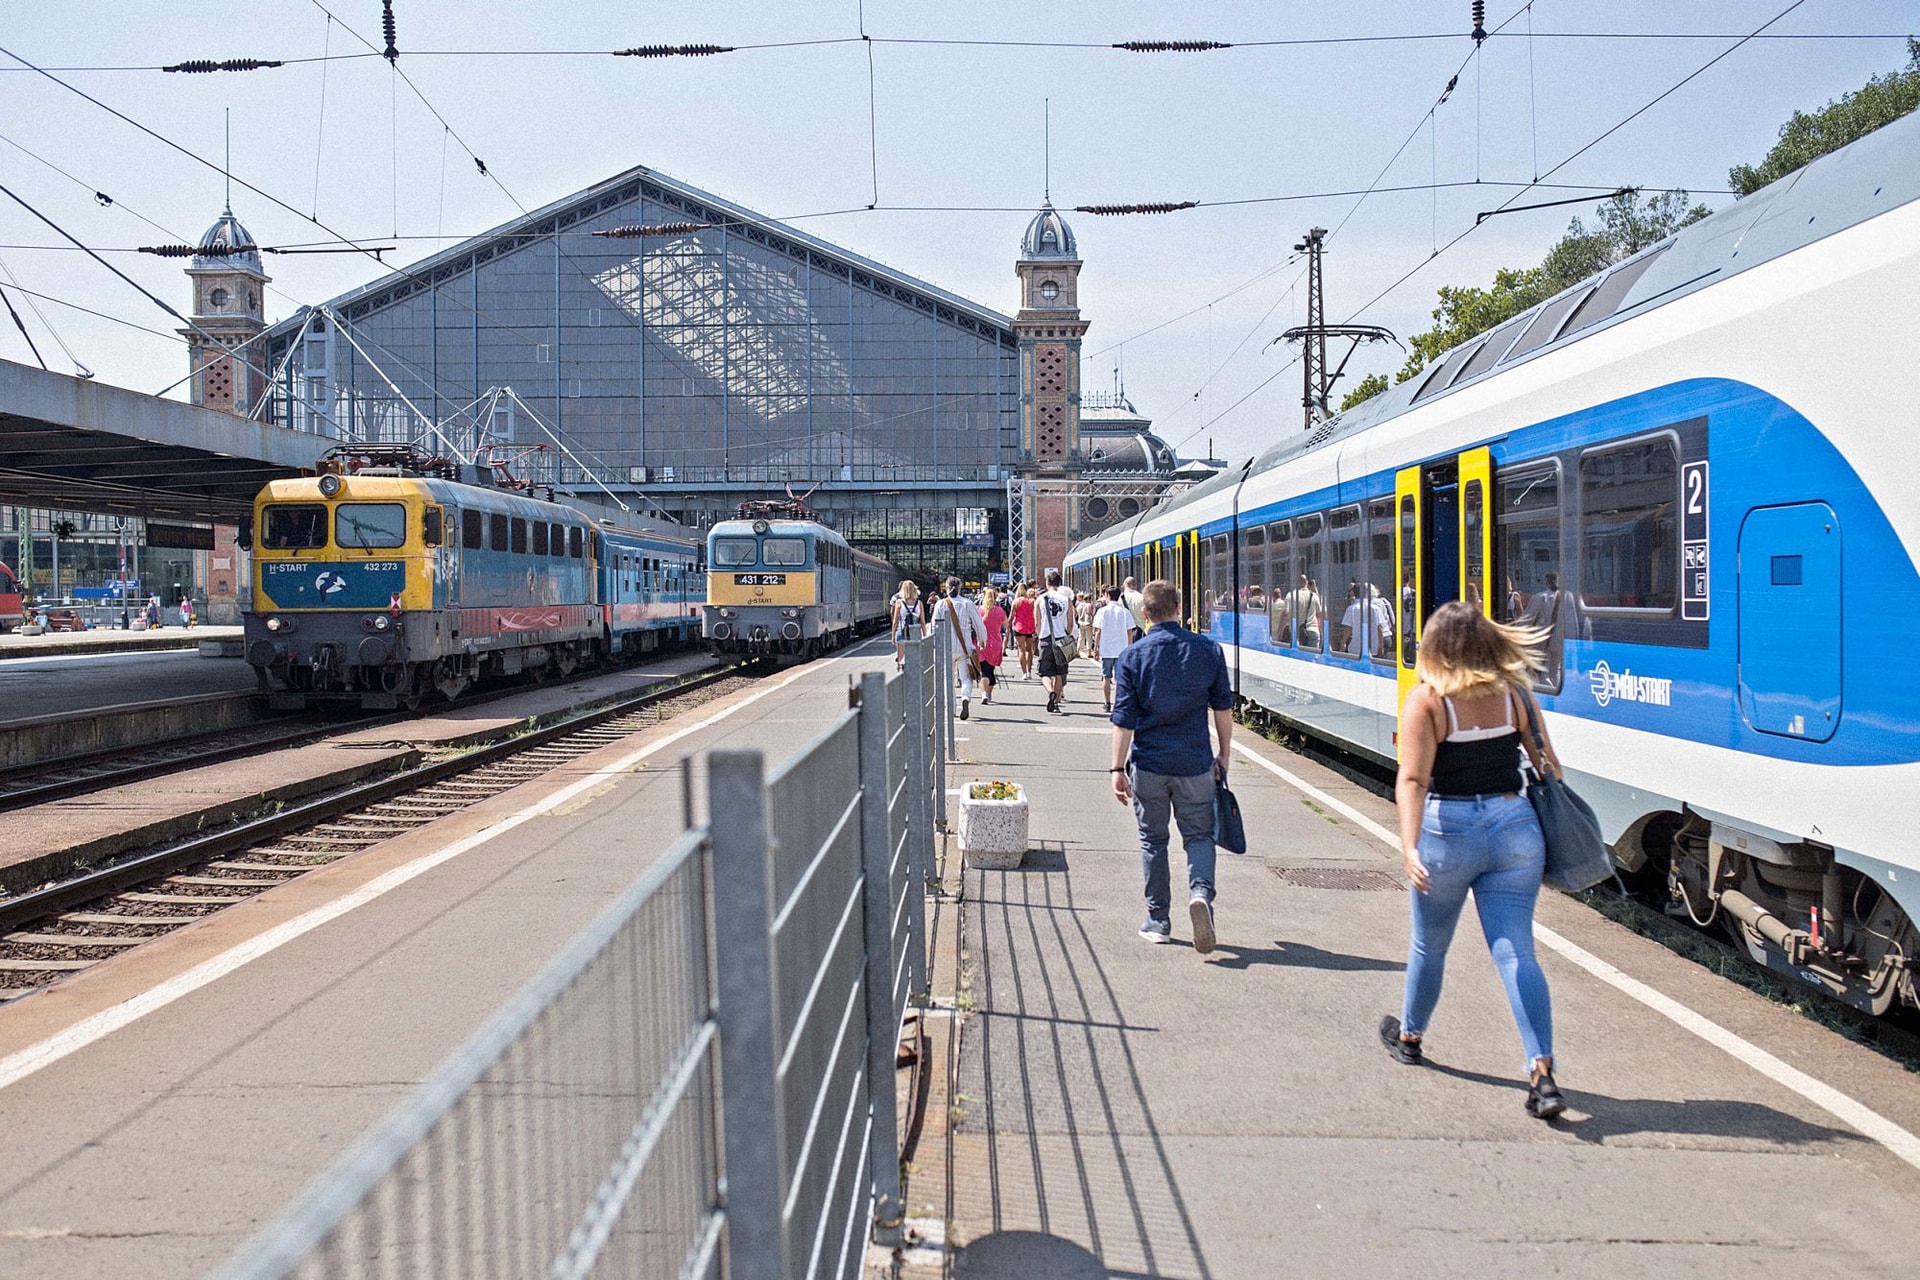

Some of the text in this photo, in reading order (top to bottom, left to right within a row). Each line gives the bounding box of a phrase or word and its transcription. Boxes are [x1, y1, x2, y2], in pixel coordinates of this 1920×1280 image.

[1688, 469, 1702, 515] 2
[364, 563, 398, 571] 432 273
[741, 575, 779, 585] 431 212
